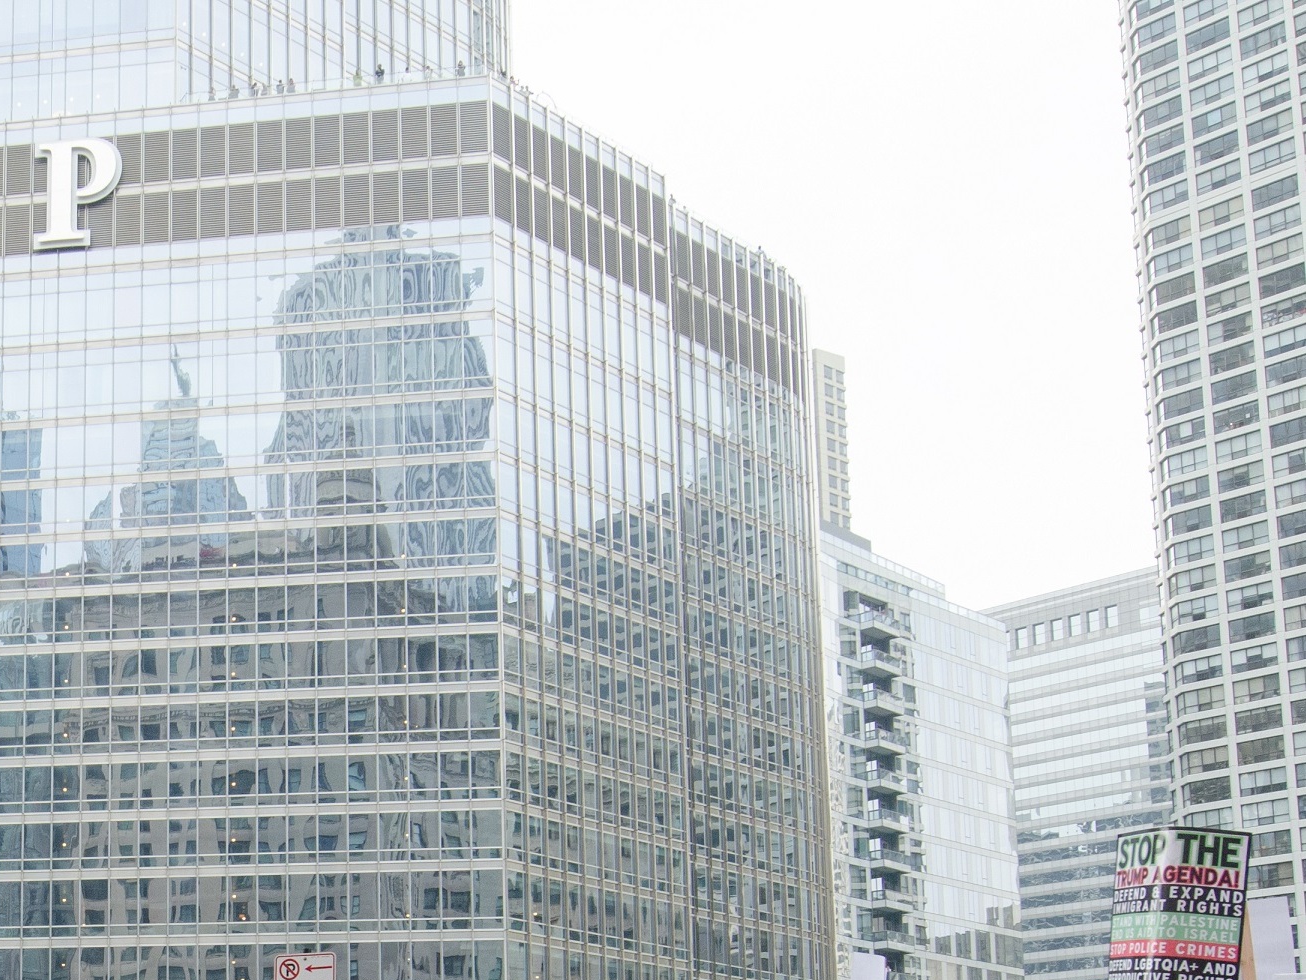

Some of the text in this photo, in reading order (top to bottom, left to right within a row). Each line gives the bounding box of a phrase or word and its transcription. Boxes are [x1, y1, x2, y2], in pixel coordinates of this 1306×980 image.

[1119, 833, 1241, 869] STOP THE
[1117, 865, 1240, 888] TRUMP AGENDA!
[1115, 886, 1243, 903] DEFEND EXPAND
[1113, 899, 1242, 917] IMMIGRANT RIGHTS
[1136, 914, 1238, 931] WITH PALESTINE
[1158, 927, 1236, 943] TO ISRAEL
[1110, 942, 1236, 959] STOP POLICE CRIMES
[1109, 958, 1236, 976] DEFEND LGBTQIA+ AND
